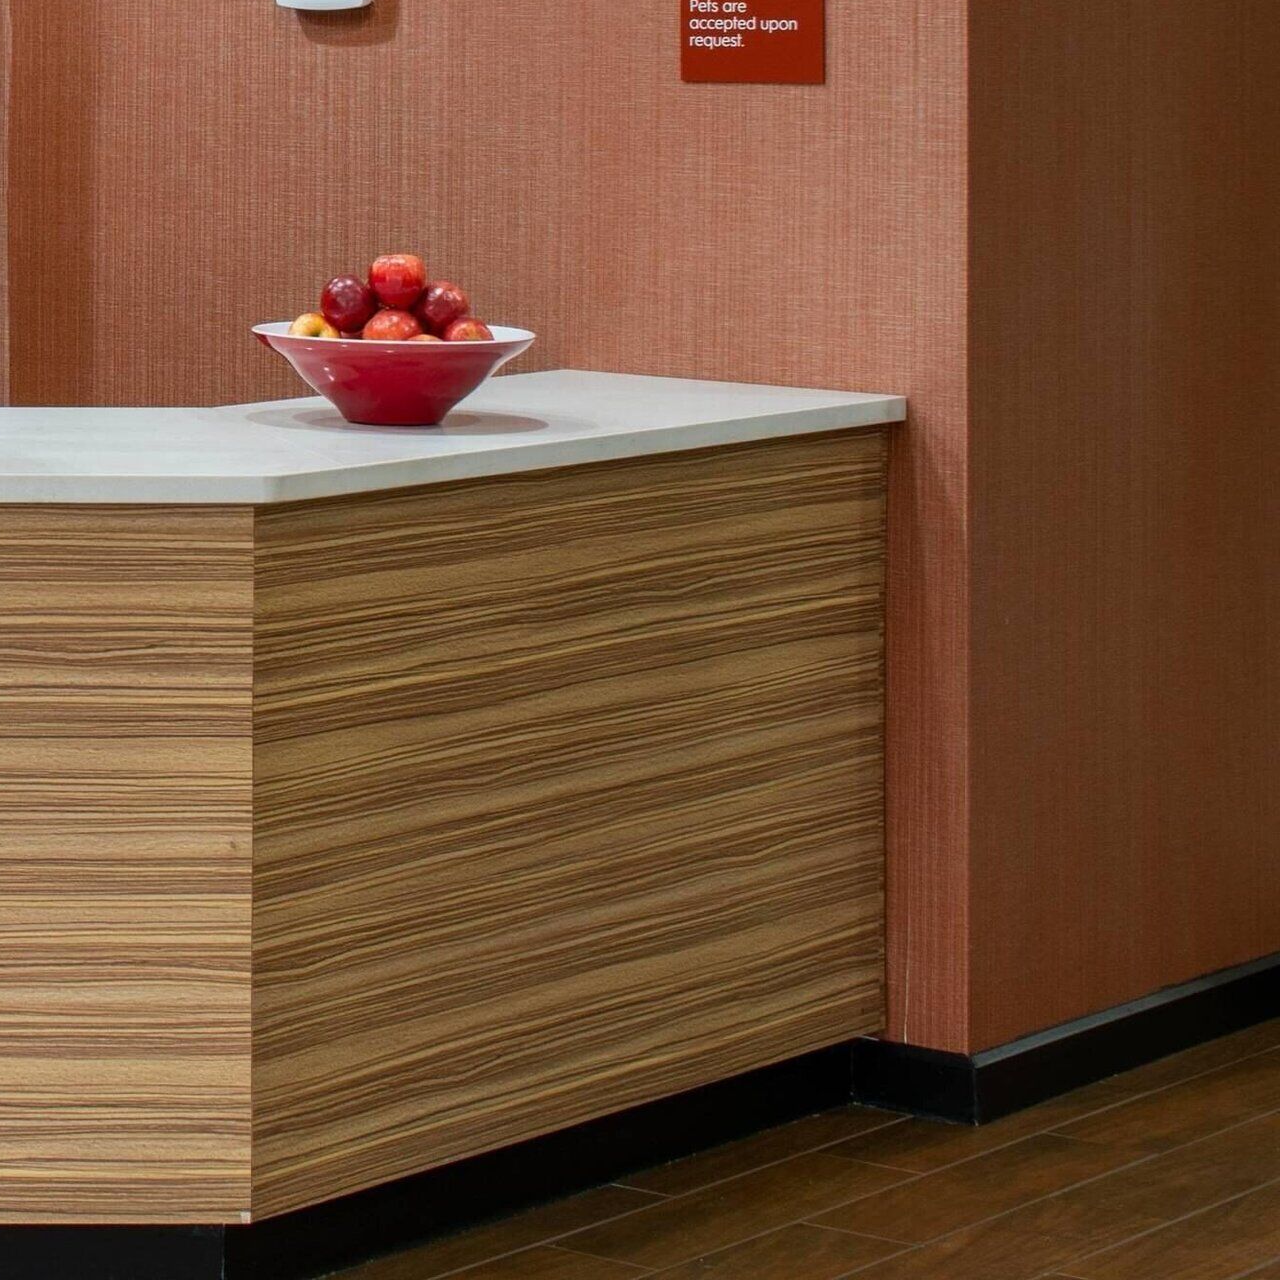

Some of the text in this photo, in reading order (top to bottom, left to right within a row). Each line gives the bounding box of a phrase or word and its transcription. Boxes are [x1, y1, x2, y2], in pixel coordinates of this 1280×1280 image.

[690, 0, 747, 12] Pets are
[689, 17, 797, 33] accepted upon
[690, 34, 744, 49] request.
